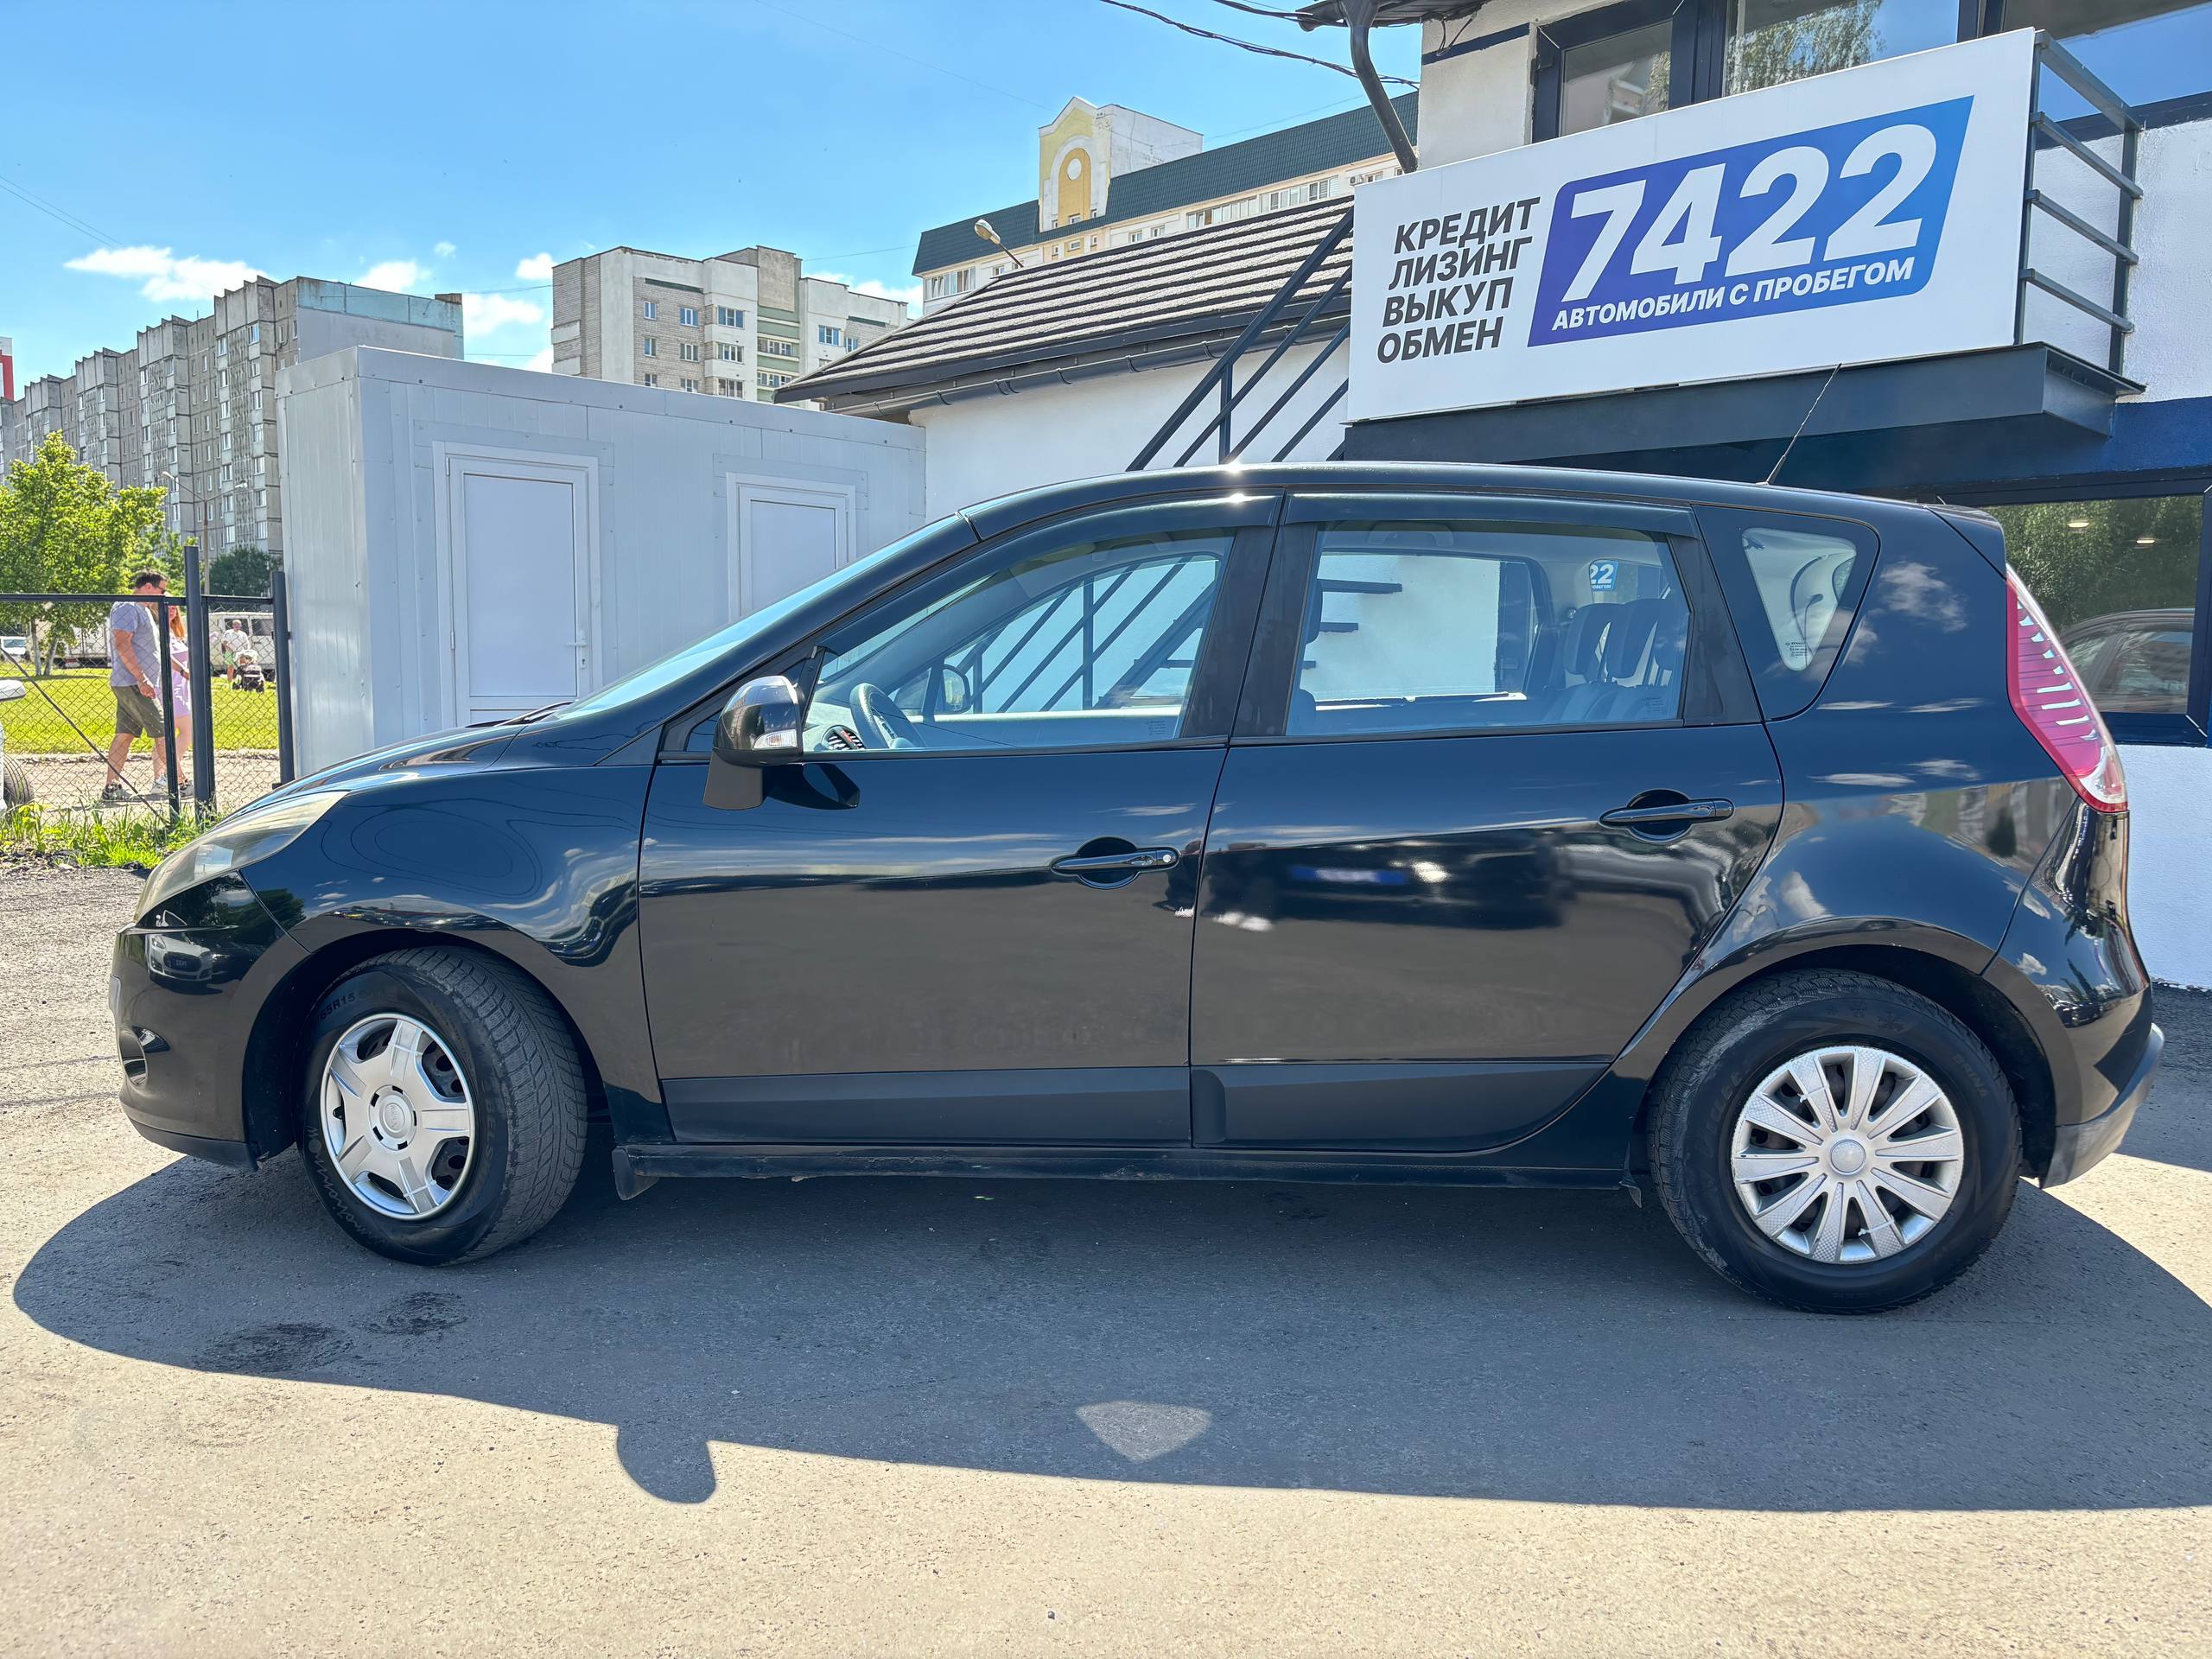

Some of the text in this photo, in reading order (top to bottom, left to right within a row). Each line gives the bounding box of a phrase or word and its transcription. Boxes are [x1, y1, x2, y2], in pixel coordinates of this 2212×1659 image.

[1394, 196, 1541, 255] КРЕДИТ
[1560, 123, 1938, 302] 7422
[1388, 235, 1533, 291] ЛИЗИНГ
[1382, 276, 1514, 327] ВЫКУП
[1551, 257, 1915, 331] АВТОМОБИЛИ С ПРОБЕГОМ
[1377, 315, 1504, 364] ОБМЕН
